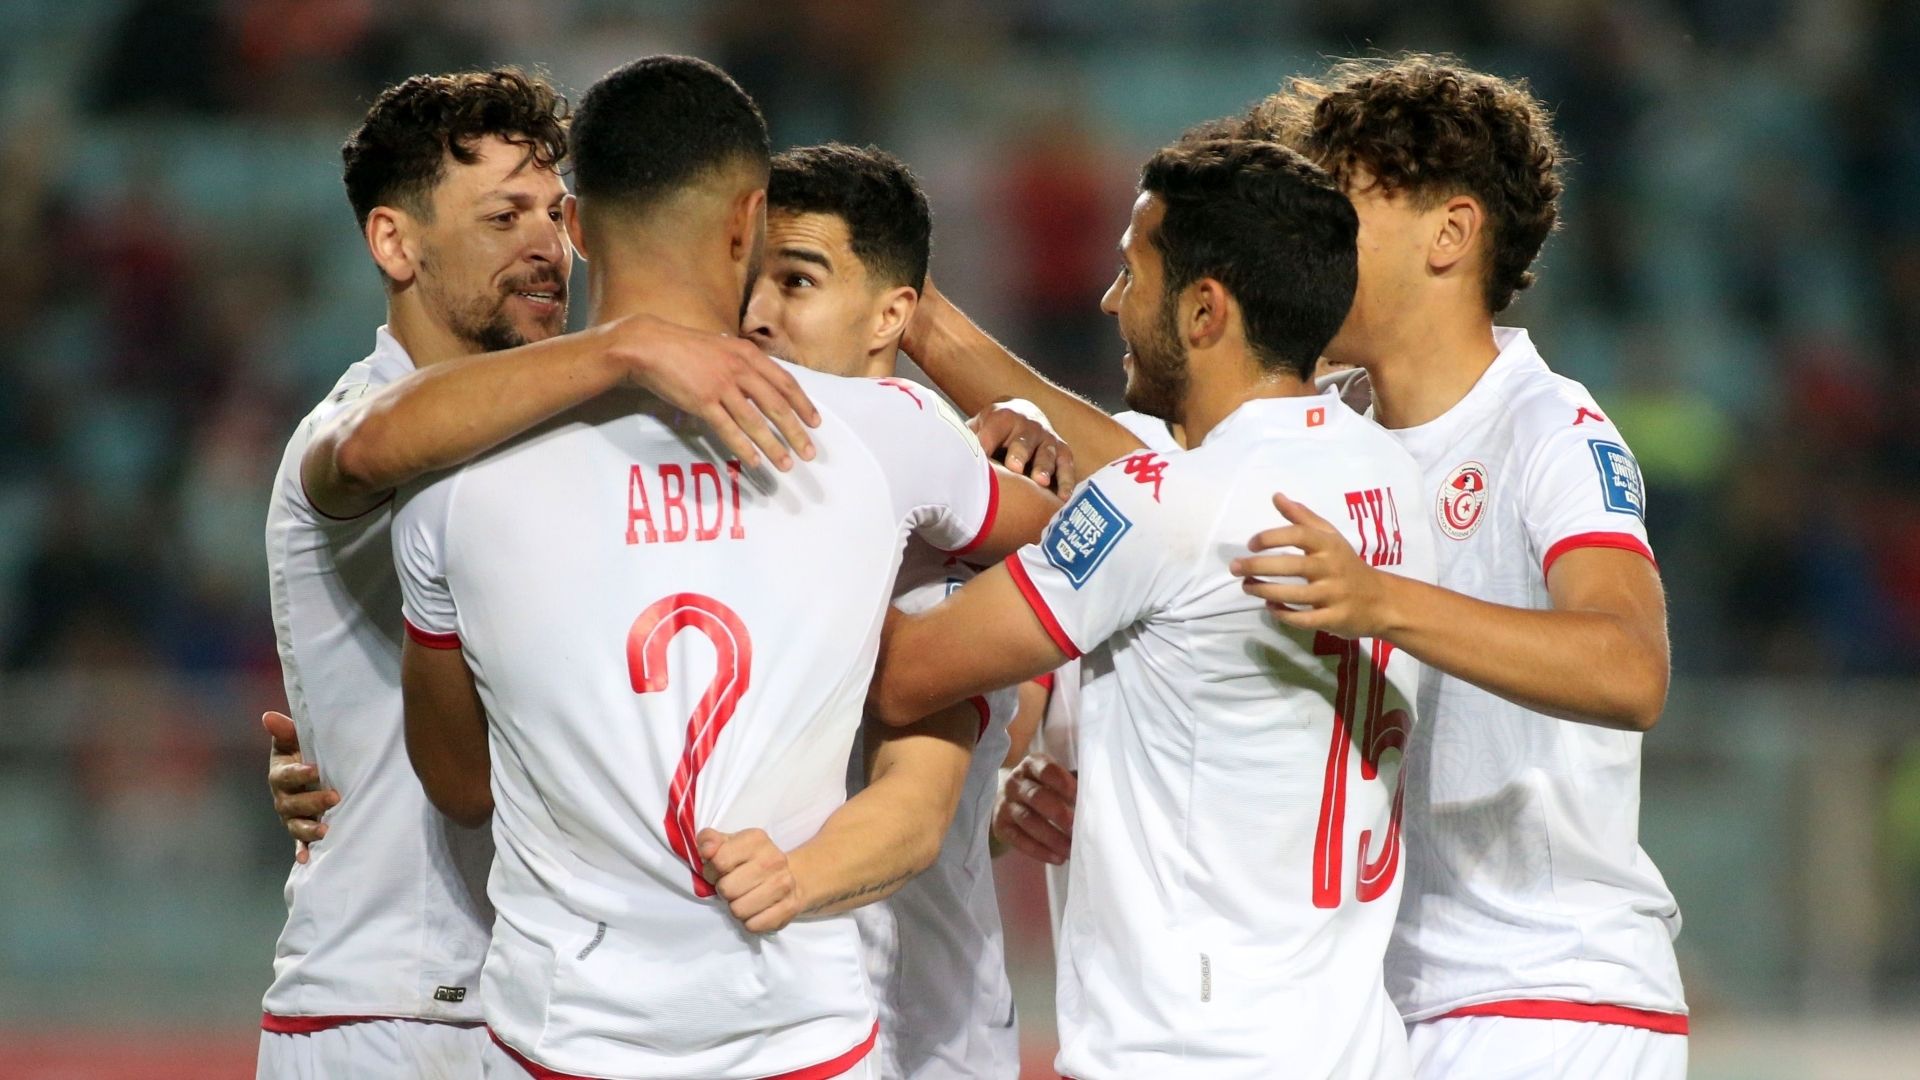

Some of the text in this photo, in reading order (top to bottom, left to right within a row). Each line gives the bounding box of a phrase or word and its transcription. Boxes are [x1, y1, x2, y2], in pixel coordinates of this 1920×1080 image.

[625, 460, 745, 544] ABDI
[1069, 507, 1102, 545] UNITES
[1077, 498, 1108, 533] FOOTBALL
[626, 592, 752, 897] 2
[1312, 630, 1414, 909] 15
